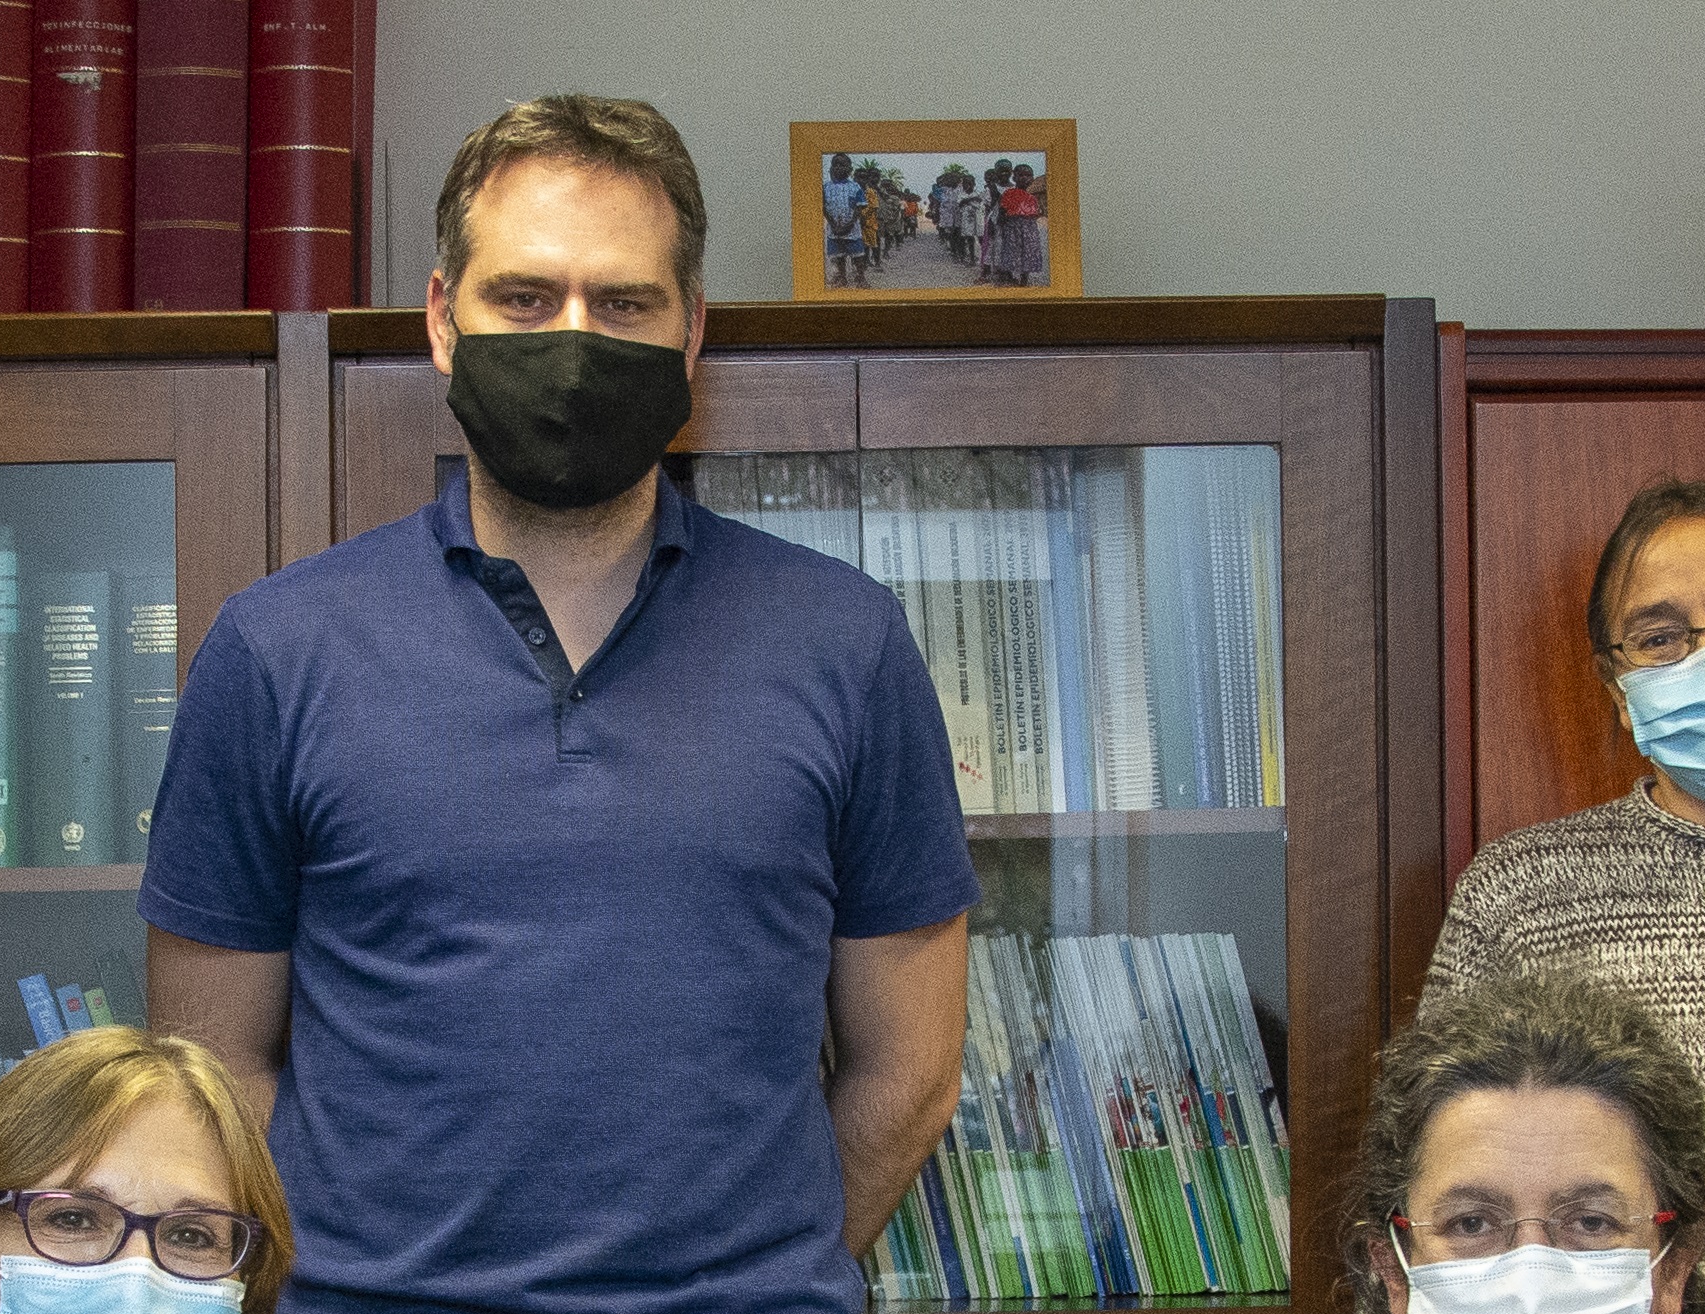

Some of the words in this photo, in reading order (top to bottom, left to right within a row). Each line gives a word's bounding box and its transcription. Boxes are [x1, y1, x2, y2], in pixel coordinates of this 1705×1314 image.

[982, 540, 996, 596] SEMANAL
[1004, 538, 1018, 593] SEMANAL
[1020, 541, 1033, 597] SEMANAL
[44, 605, 95, 613] INTERNATIONAL
[44, 624, 96, 632] CLASSIFICATION
[49, 615, 89, 623] STATISTICAL
[954, 606, 966, 648] ENFERMEDADES
[43, 643, 71, 651] RELATED
[73, 642, 98, 651] HEALTH
[51, 634, 84, 642] DISEASES
[85, 633, 99, 641] AND
[52, 652, 89, 660] PROBLEMS
[957, 649, 967, 660] LAS
[987, 598, 1003, 700] EPIDEMIOLÓGICO
[1008, 595, 1025, 698] EPIDEMIOLÓGICO
[993, 703, 1007, 754] BOLETÍN
[1014, 700, 1028, 752] BOLETÍN
